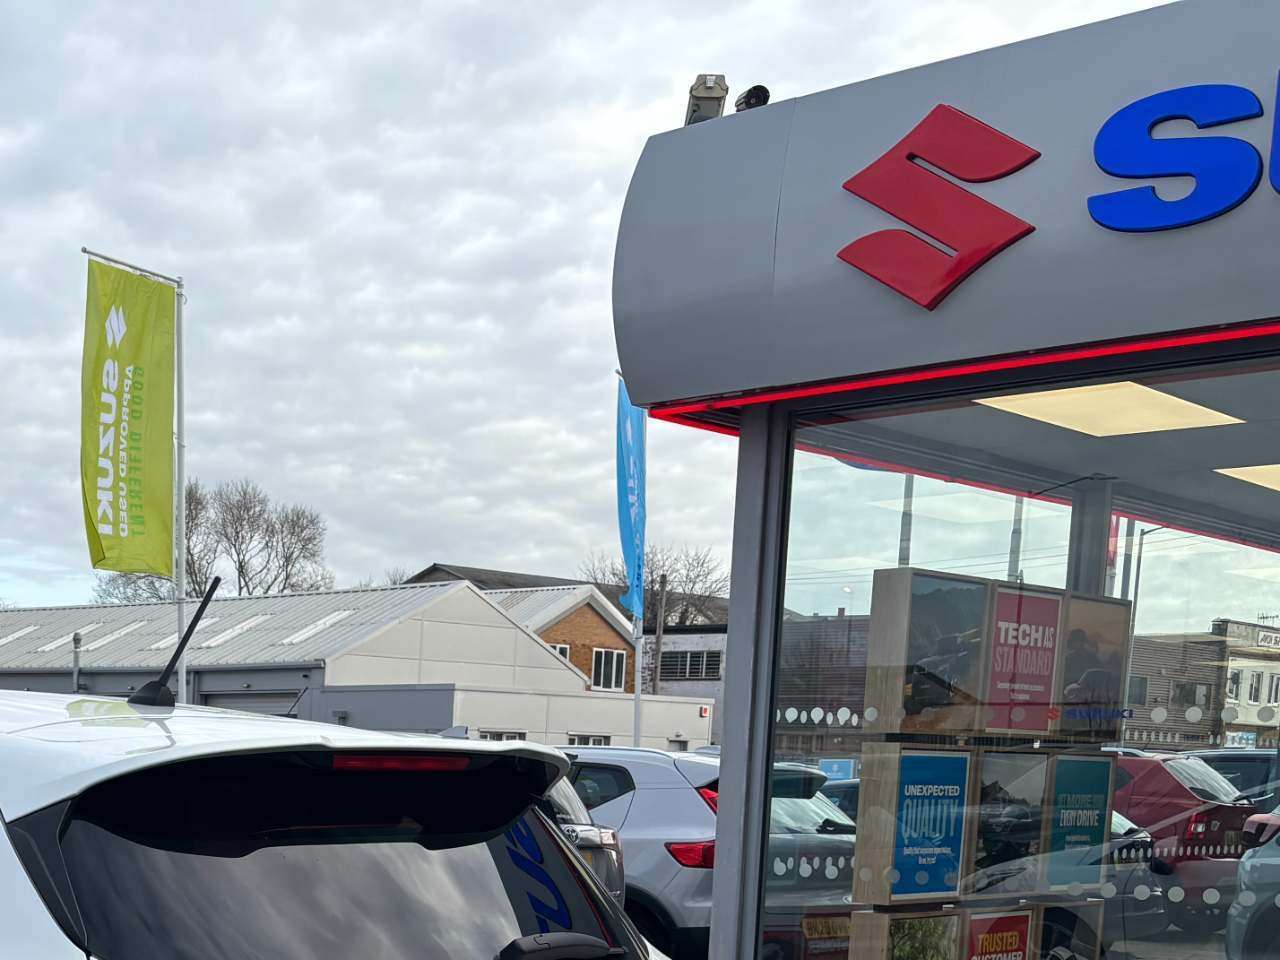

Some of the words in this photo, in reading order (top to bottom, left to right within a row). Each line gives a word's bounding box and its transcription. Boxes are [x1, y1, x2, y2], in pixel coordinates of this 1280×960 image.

[1087, 69, 1280, 232] S
[998, 621, 1043, 647] TECH
[1043, 626, 1055, 648] AS
[994, 647, 1052, 675] STANDARD
[904, 785, 960, 796] UNEXPECTED
[903, 799, 959, 845] QUALITY
[1077, 810, 1100, 827] DRIVE
[978, 931, 1020, 953] TRUSTED
